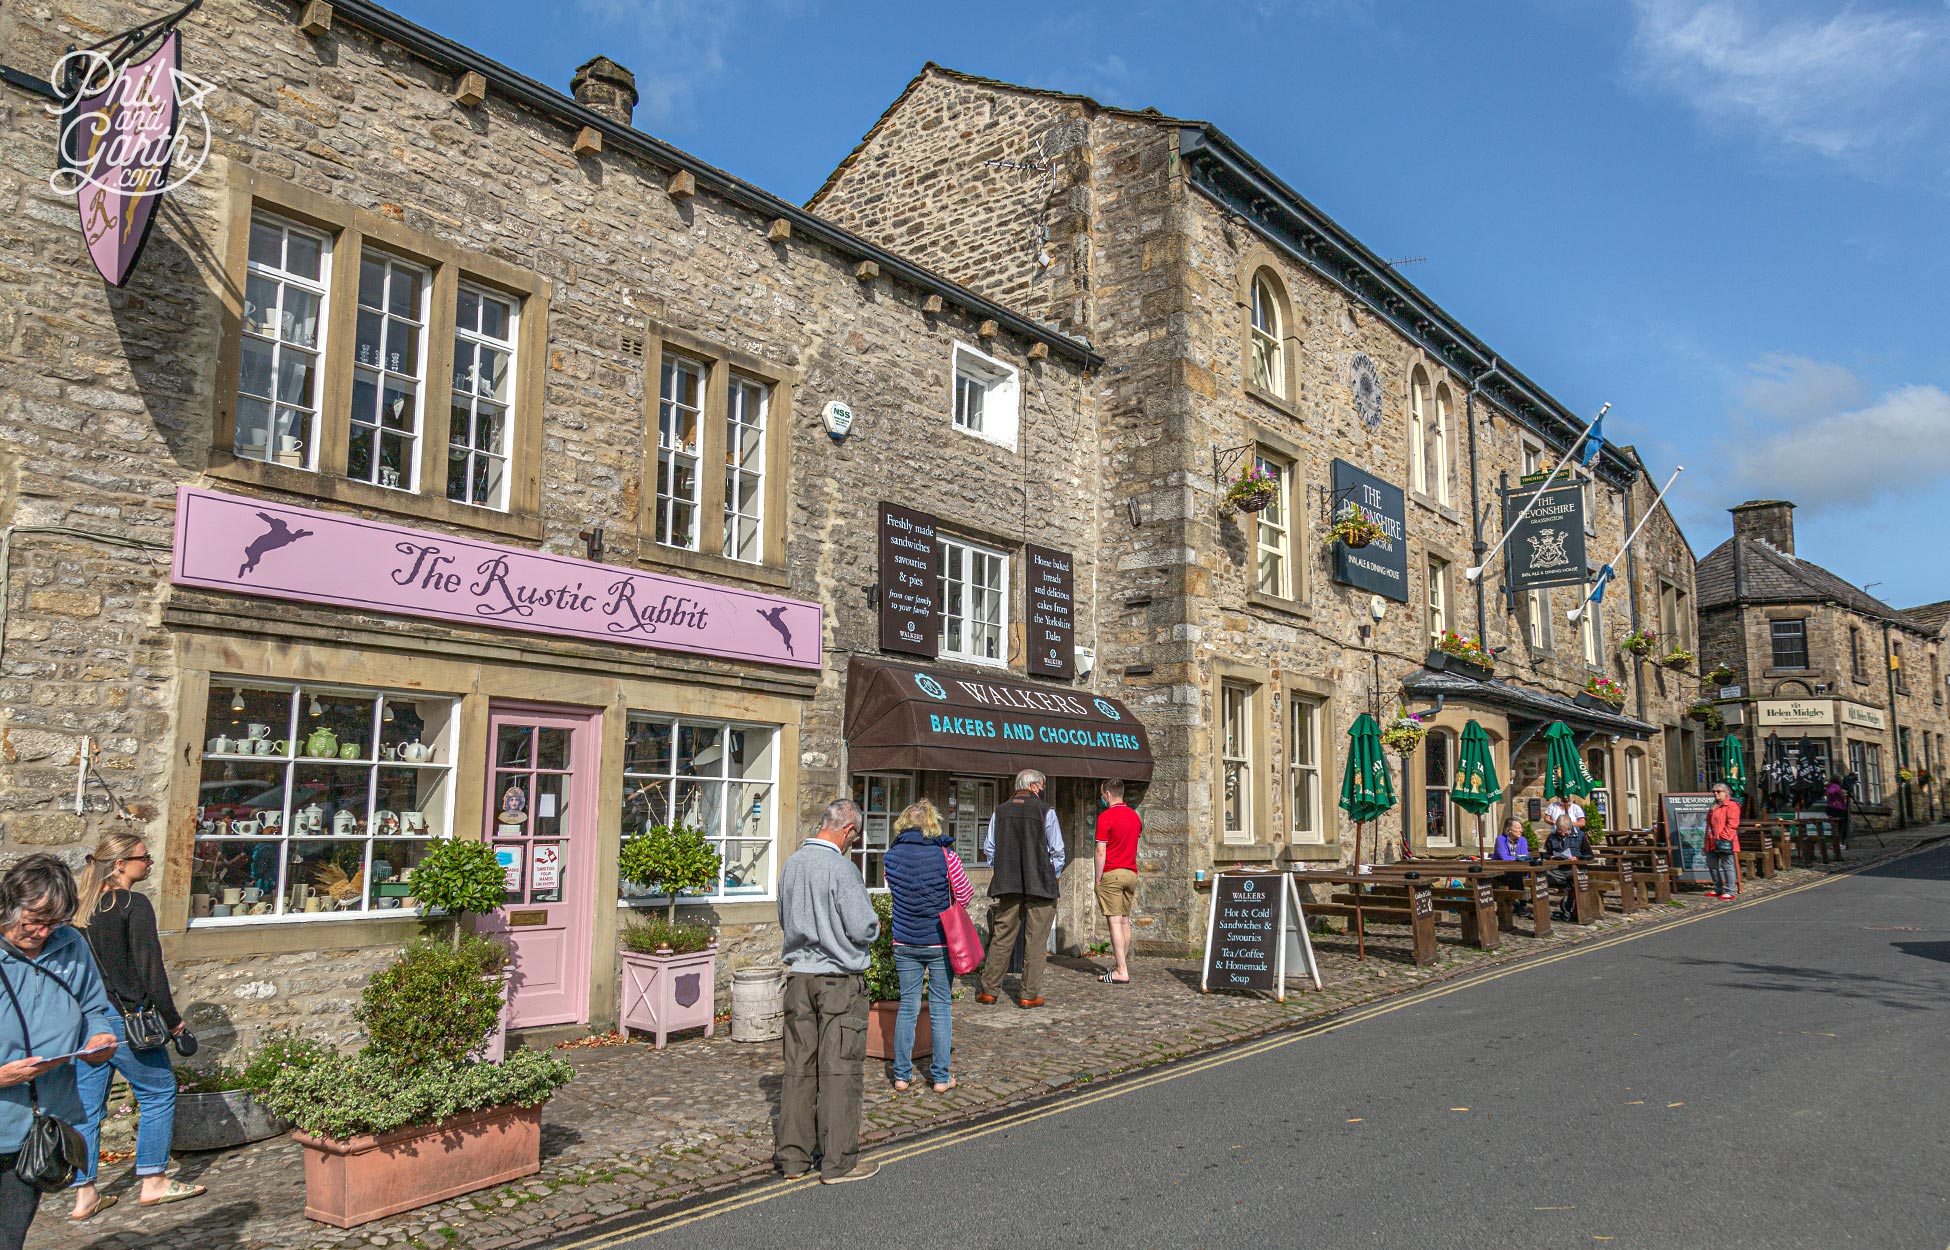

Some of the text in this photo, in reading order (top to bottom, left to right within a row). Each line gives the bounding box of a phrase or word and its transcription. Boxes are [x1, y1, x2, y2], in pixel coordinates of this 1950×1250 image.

[833, 407, 851, 419] NSS
[1363, 484, 1382, 510] THE
[1537, 496, 1555, 507] THE
[886, 513, 934, 537] Freshly made
[890, 535, 931, 554] sandwiches
[894, 555, 927, 570] savouries
[1034, 554, 1070, 572] Home baked
[899, 571, 924, 587] & pies
[1042, 570, 1062, 584] breads
[391, 542, 709, 634] The Rustic Rabbit
[1034, 585, 1070, 600] and delicious
[888, 588, 932, 607] from our family
[898, 604, 912, 612] your
[912, 605, 930, 618] family
[1036, 599, 1068, 614] cakes from
[1033, 612, 1071, 630] the Yorkshire
[899, 630, 924, 641] WALKERS
[1045, 630, 1062, 642] Dales
[956, 680, 1088, 715] WALKERS
[1767, 708, 1825, 718] Helen Midgley
[930, 714, 1139, 750] BAKERS AND CHOCOLATIERS
[1668, 796, 1682, 804] THE
[1232, 892, 1266, 901] WALKERS
[1224, 907, 1270, 918] Hot & Cold
[1219, 920, 1272, 930] Sandwiches &
[1226, 932, 1262, 942] Savouries
[1221, 947, 1265, 959] Tea/Coffee
[1215, 960, 1268, 972] & Homemade
[1230, 973, 1250, 985] Soup
